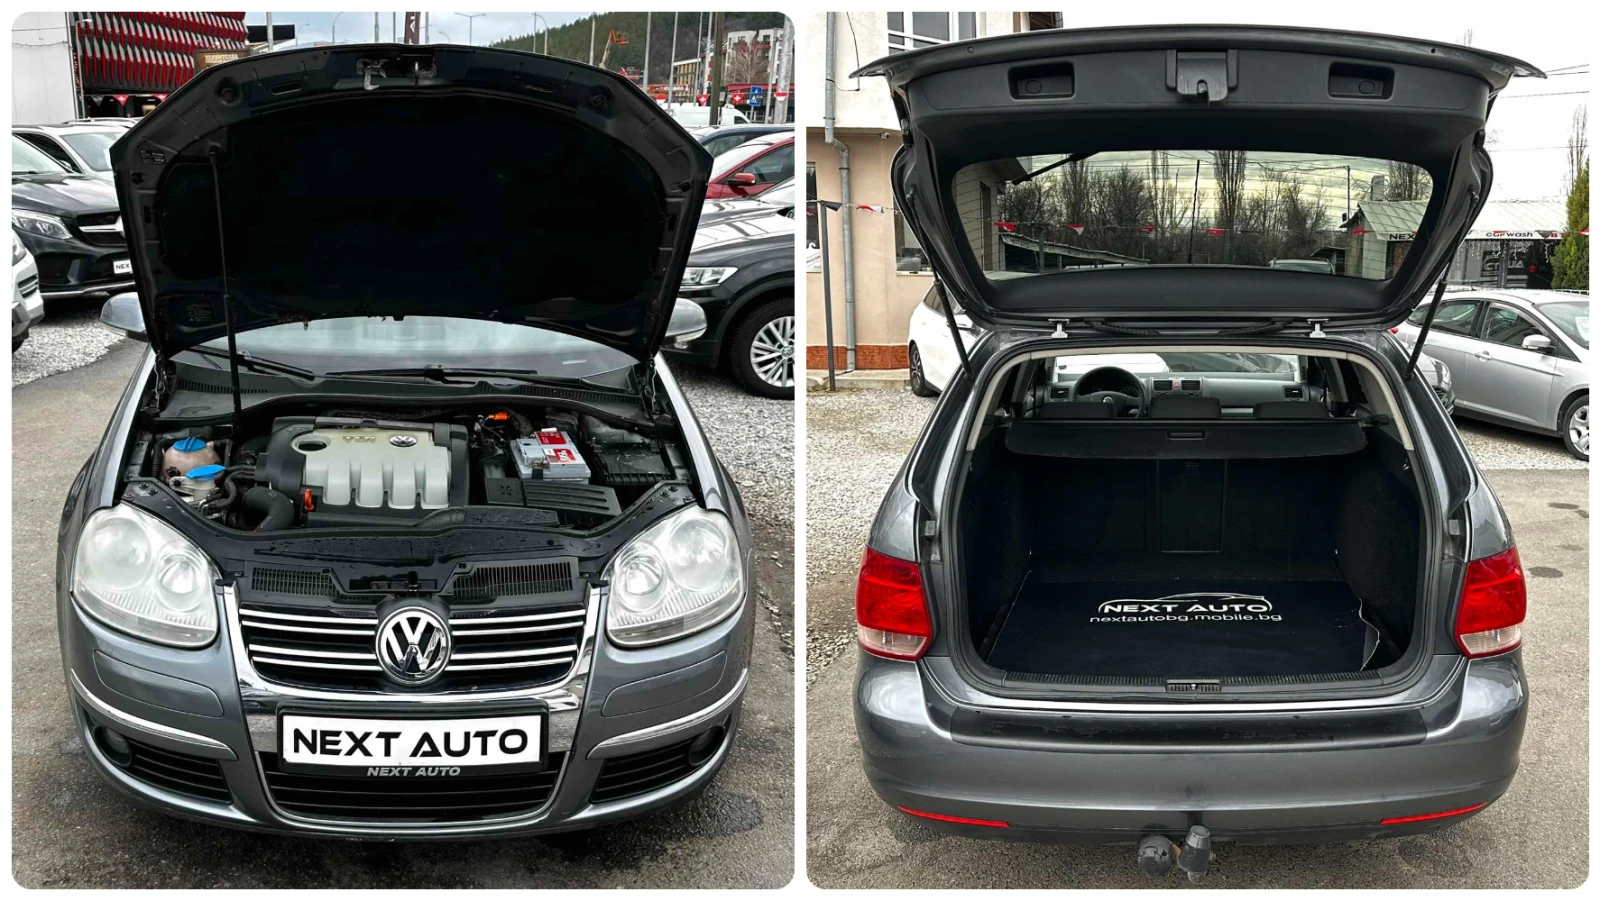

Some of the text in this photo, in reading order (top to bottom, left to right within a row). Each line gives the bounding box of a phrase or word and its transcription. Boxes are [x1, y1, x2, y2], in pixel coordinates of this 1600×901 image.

[1104, 603, 1268, 613] NEXT AUTO
[1089, 613, 1283, 623] nextautobg.mobile.bg
[293, 728, 529, 757] NEXT AUTO
[366, 766, 461, 777] NEXT AUTO
